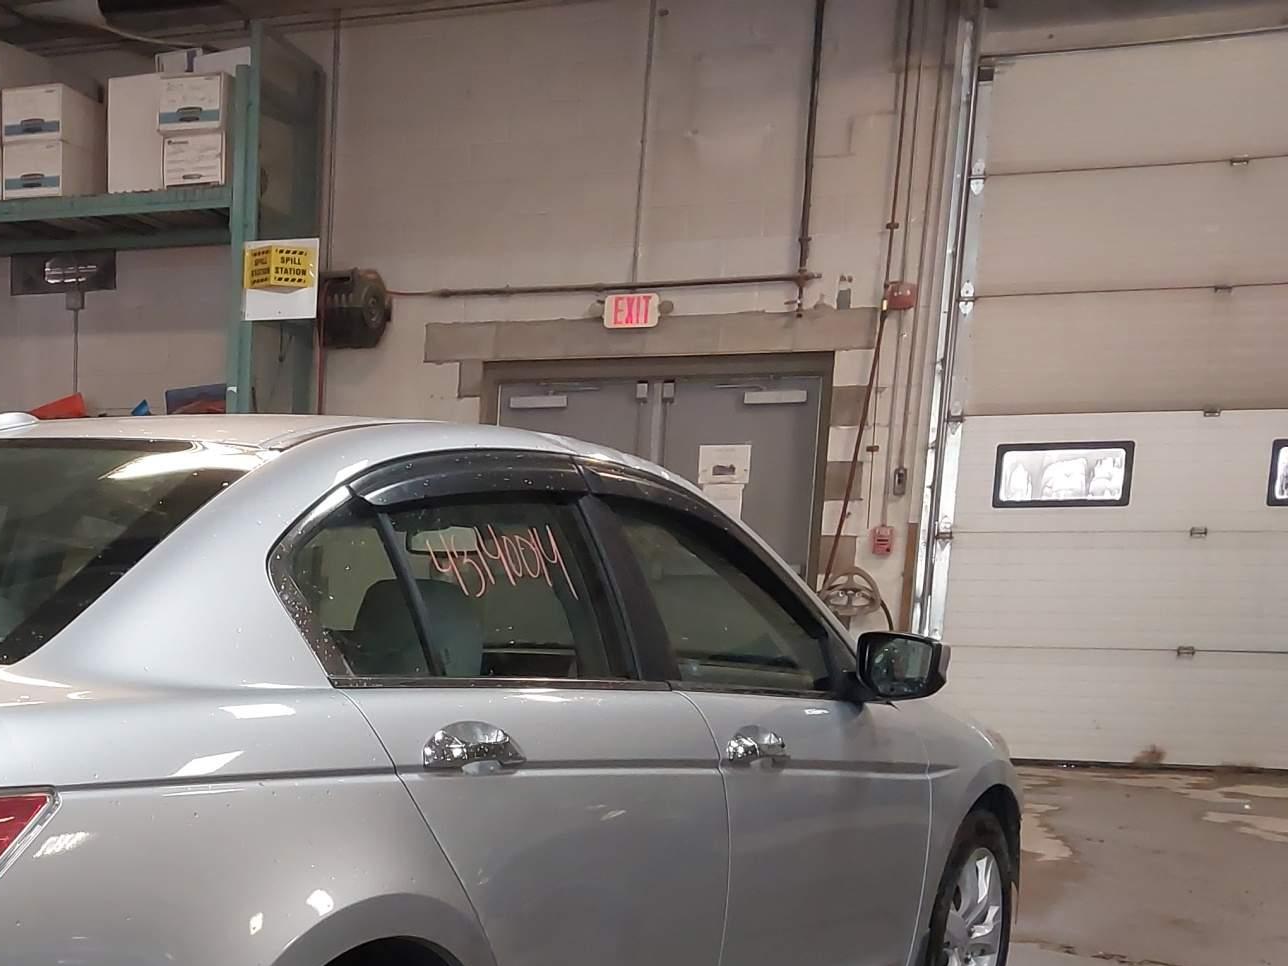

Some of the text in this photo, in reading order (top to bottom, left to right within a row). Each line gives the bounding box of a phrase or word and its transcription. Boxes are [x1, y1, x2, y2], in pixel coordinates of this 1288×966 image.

[280, 256, 302, 266] SPILL
[274, 266, 307, 276] STATION
[613, 295, 652, 325] EXIT
